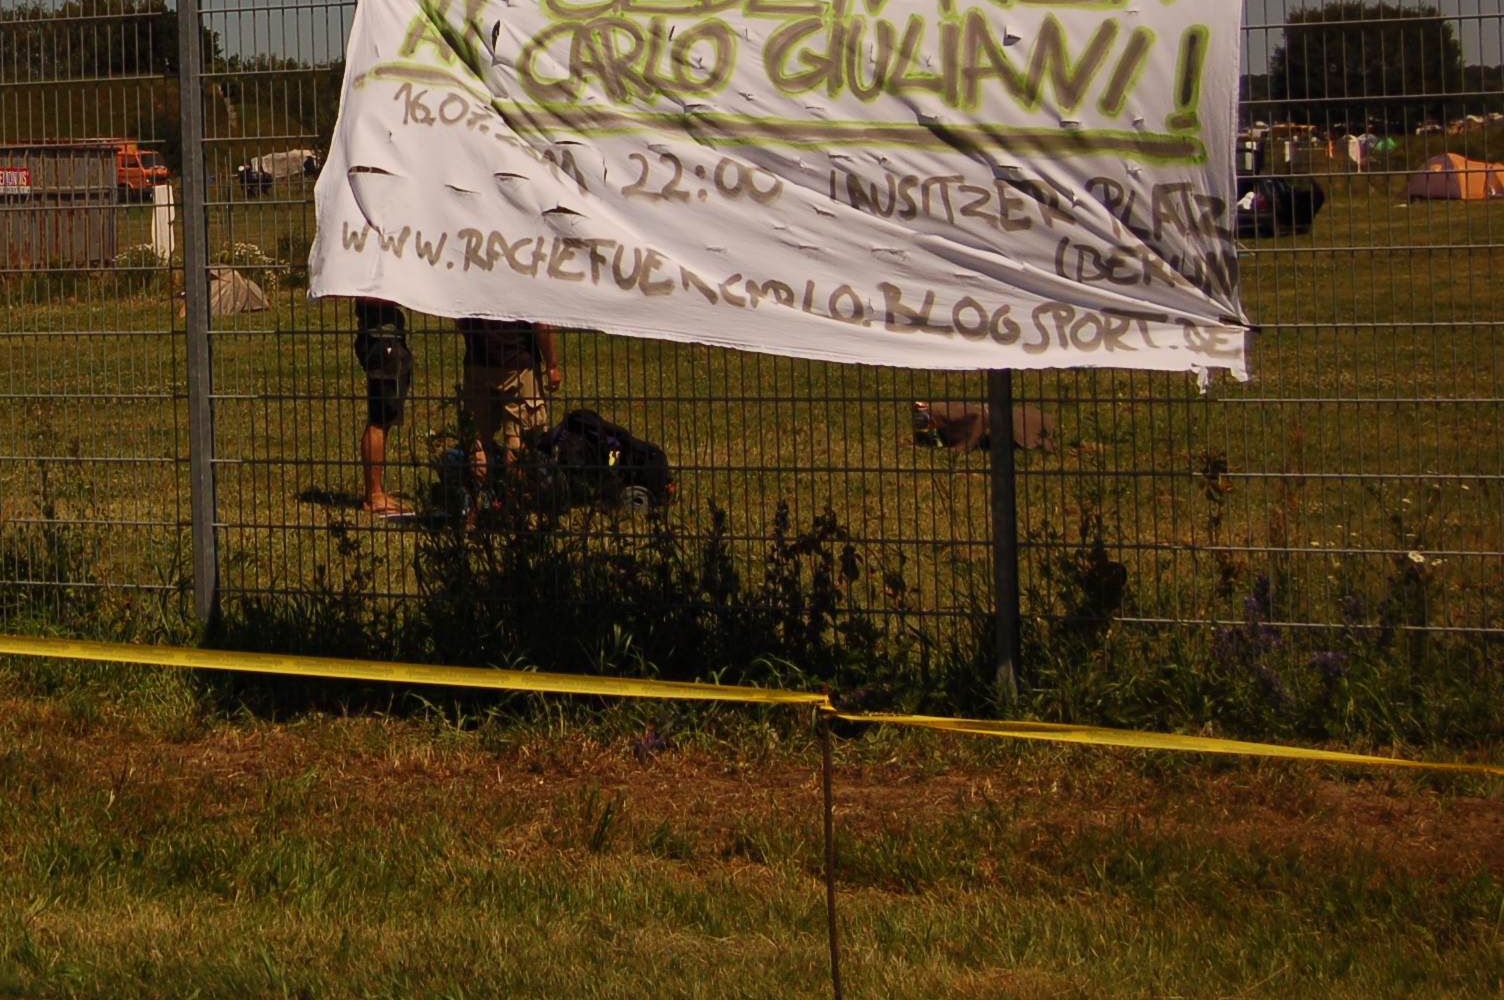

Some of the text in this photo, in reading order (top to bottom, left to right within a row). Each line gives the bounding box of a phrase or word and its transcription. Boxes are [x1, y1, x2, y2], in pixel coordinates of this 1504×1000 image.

[518, 14, 738, 104] CARLO
[763, 7, 1209, 132] GIULIANI!
[621, 153, 784, 204] 22:00
